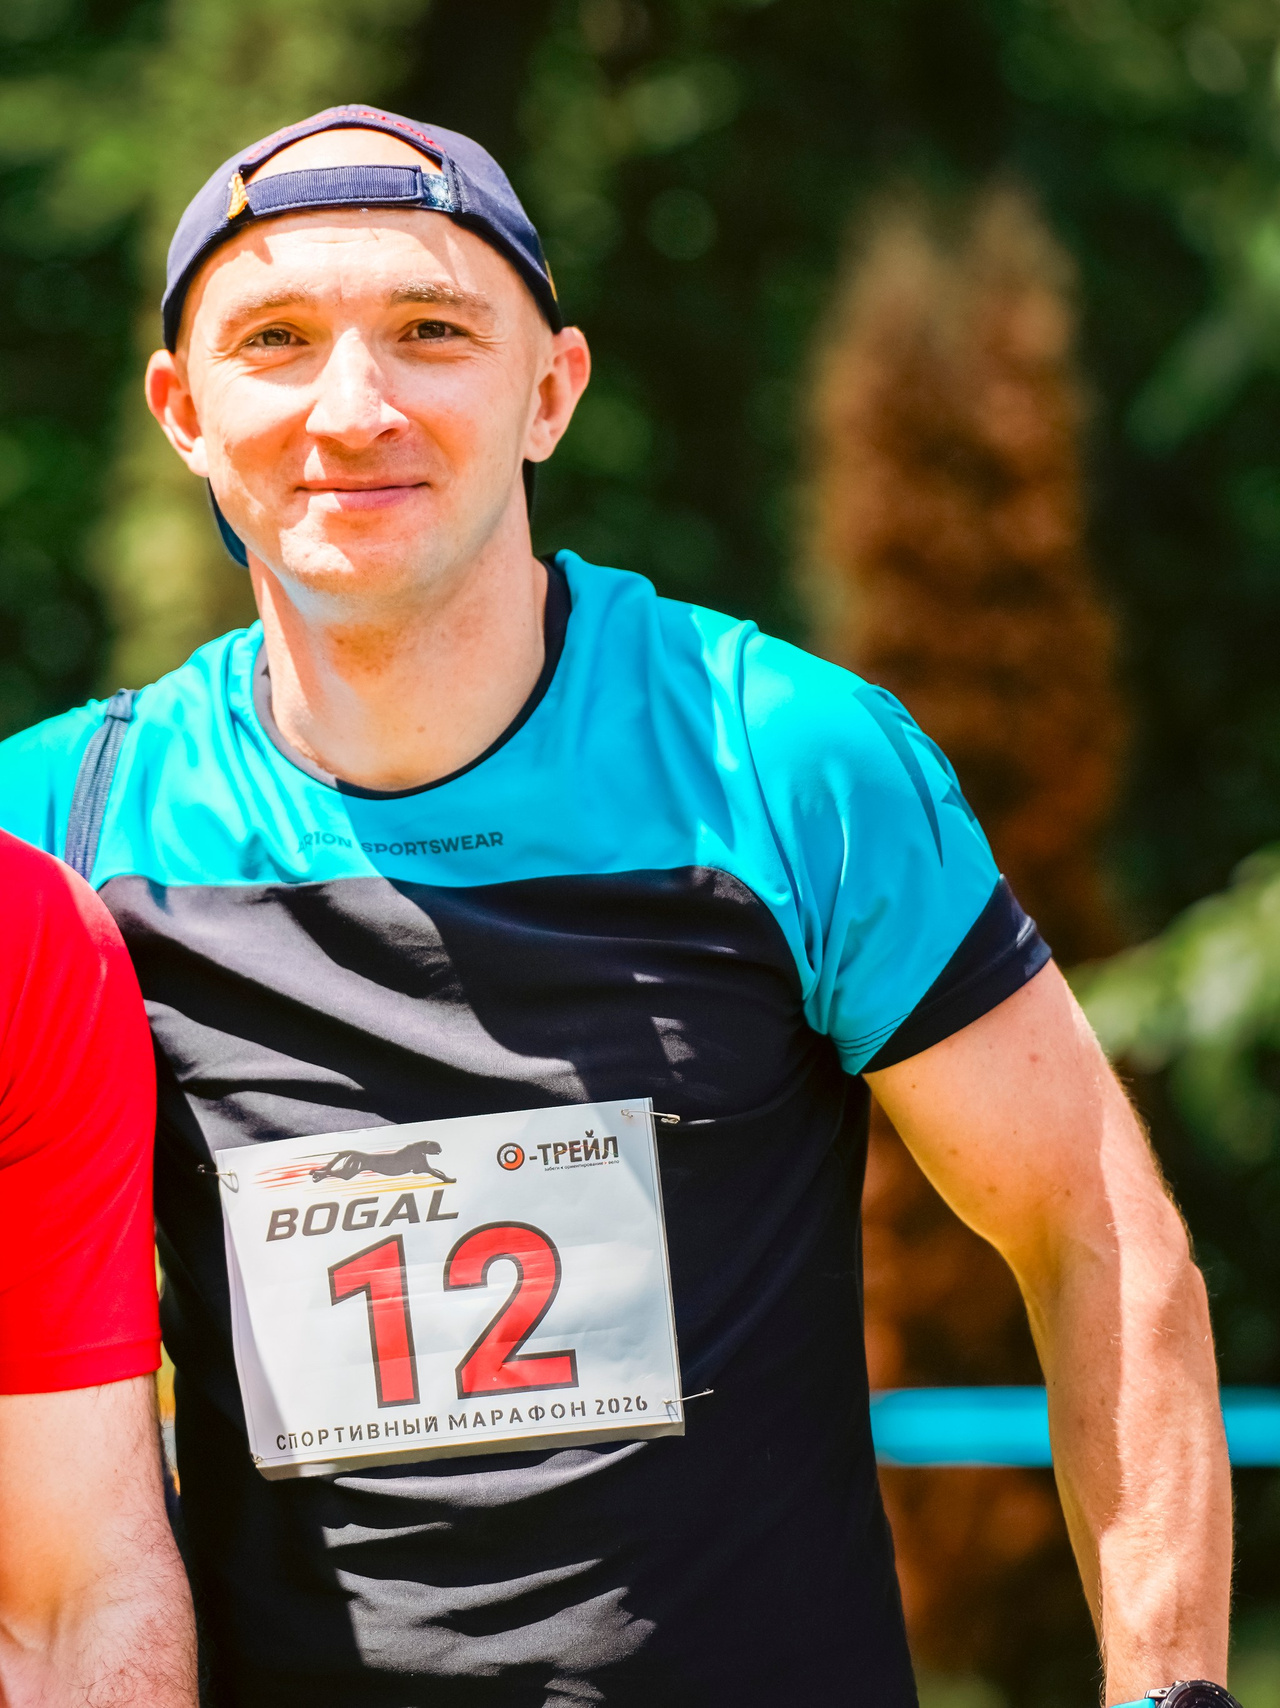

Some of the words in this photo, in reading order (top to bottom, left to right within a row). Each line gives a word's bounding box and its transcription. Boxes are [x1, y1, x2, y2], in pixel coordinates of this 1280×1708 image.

[361, 831, 504, 856] SPORTSWEAR
[266, 1188, 460, 1242] BOGAL
[327, 1220, 580, 1409] 12
[276, 1415, 439, 1451] СПОРТИВНЫЙ
[448, 1400, 587, 1431] МАРАФОН
[595, 1395, 649, 1416] 2026
